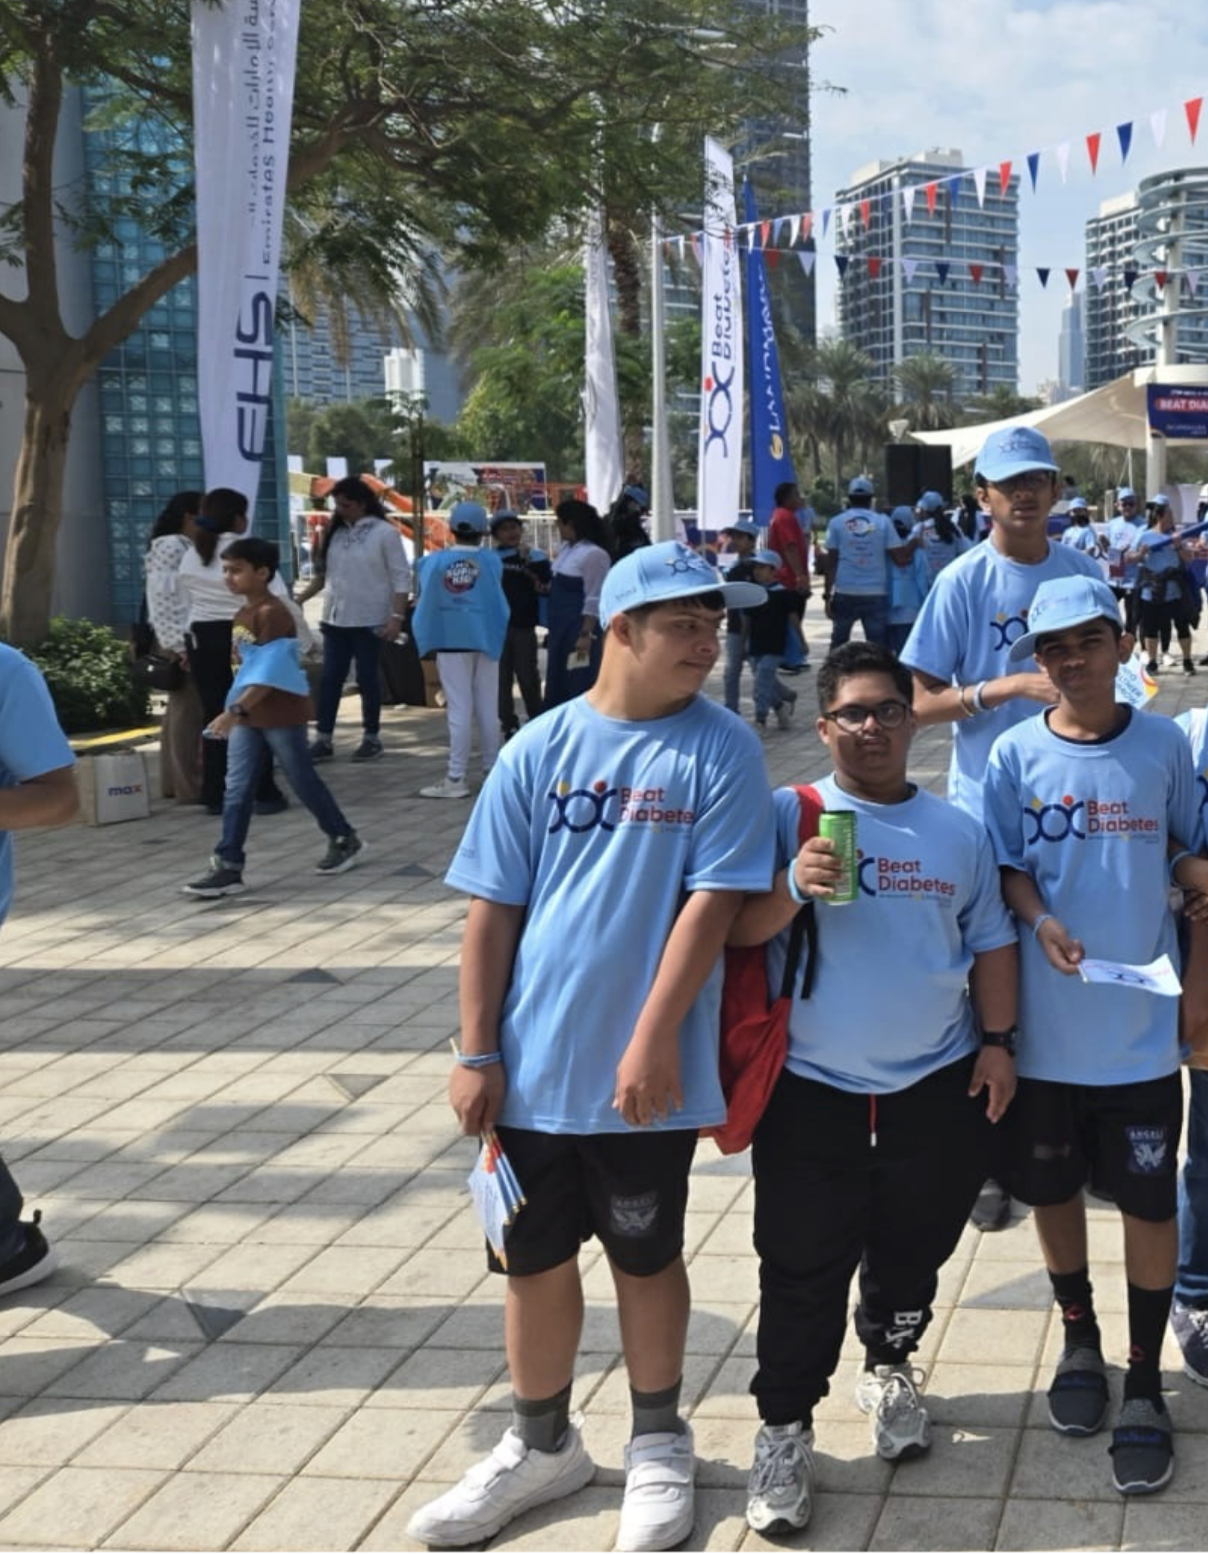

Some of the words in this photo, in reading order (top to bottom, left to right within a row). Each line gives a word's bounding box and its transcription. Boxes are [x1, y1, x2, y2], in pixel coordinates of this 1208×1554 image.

[712, 294, 722, 356] Beat
[234, 291, 273, 462] EHS
[1160, 399, 1187, 411] BEAT
[108, 784, 142, 797] max
[620, 787, 665, 804] Beat
[620, 807, 695, 824] Diabete
[1087, 800, 1128, 816] Beat
[877, 858, 921, 873] Beat
[877, 875, 956, 896] Diabetes
